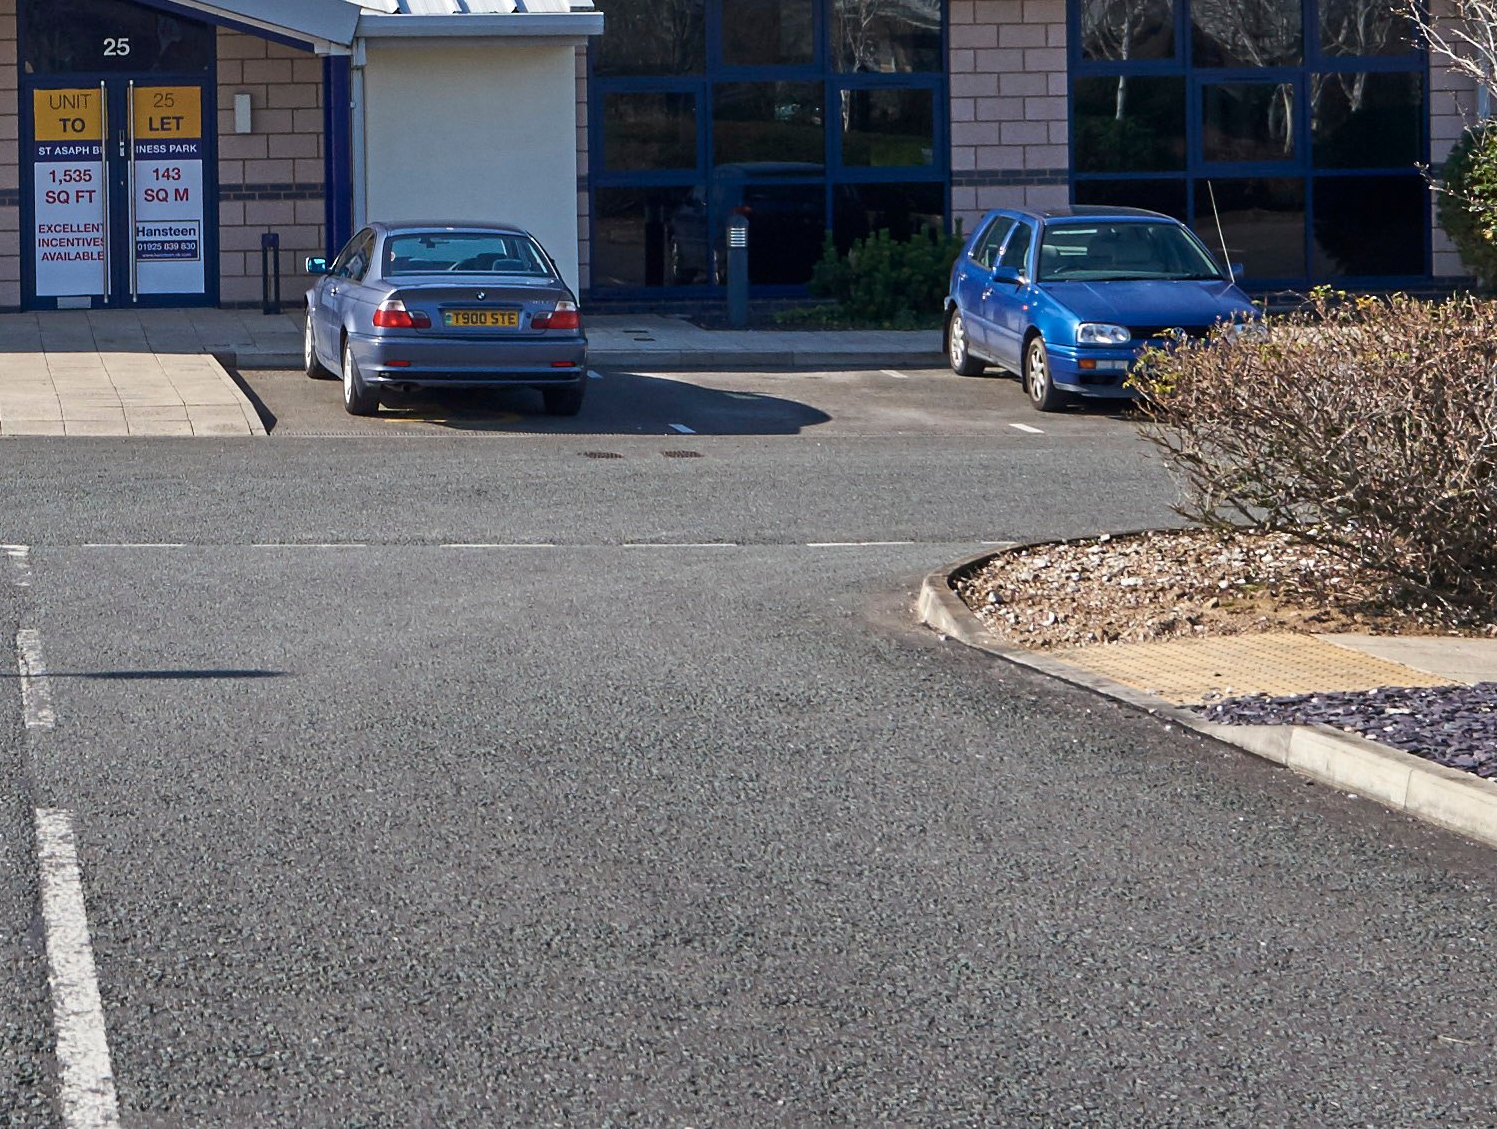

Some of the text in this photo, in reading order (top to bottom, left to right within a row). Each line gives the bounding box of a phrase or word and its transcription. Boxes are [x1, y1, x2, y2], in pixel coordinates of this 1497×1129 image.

[103, 38, 130, 56] 25
[48, 92, 175, 110] UNIT 25
[59, 116, 184, 133] TO LET
[38, 146, 52, 155] ST
[54, 146, 90, 155] ASAPH
[169, 144, 197, 153] PARK
[49, 169, 92, 186] 1,535
[153, 167, 181, 181] 143
[45, 190, 96, 204] SQ FT
[144, 188, 189, 203] SQ M
[136, 226, 196, 237] Hansteen
[41, 251, 104, 261] AVAILABLE
[454, 312, 516, 325] T900 STE
